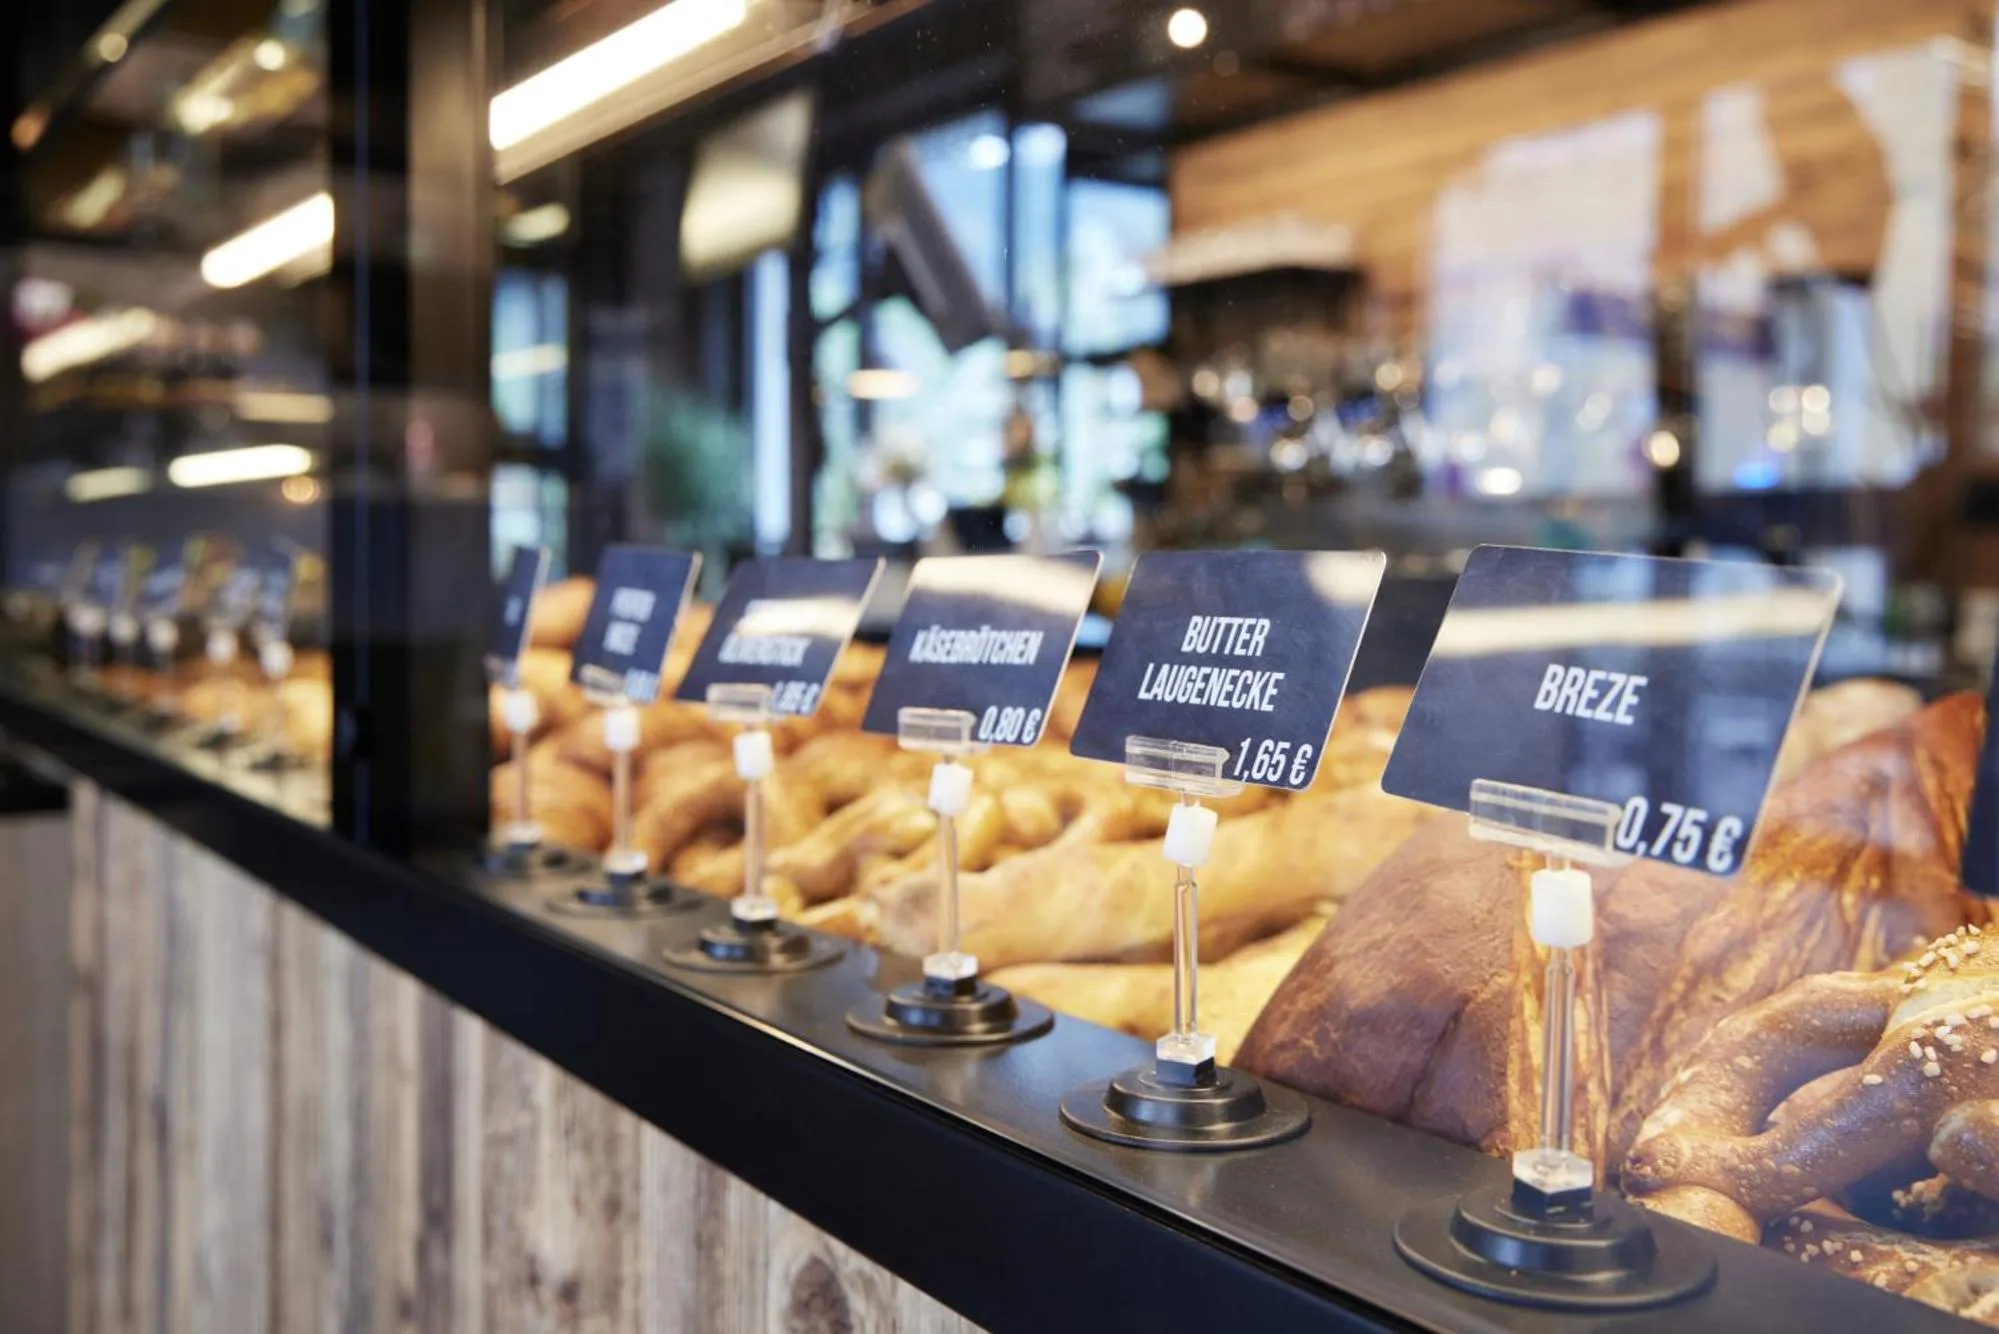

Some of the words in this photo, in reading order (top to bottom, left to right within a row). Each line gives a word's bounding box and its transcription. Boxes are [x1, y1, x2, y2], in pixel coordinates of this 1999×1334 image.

[908, 624, 1045, 665] KÄSEBRÖTCHEN
[1181, 615, 1271, 657] BUTTER
[1137, 662, 1286, 712] LAUGENECKE
[1533, 663, 1649, 726] BREZE
[978, 705, 1026, 746] 0,80
[1021, 708, 1042, 744] €
[1233, 737, 1291, 783] 1,65
[1289, 743, 1313, 786] €
[1616, 796, 1708, 864] 0,75
[1706, 815, 1744, 873] €
